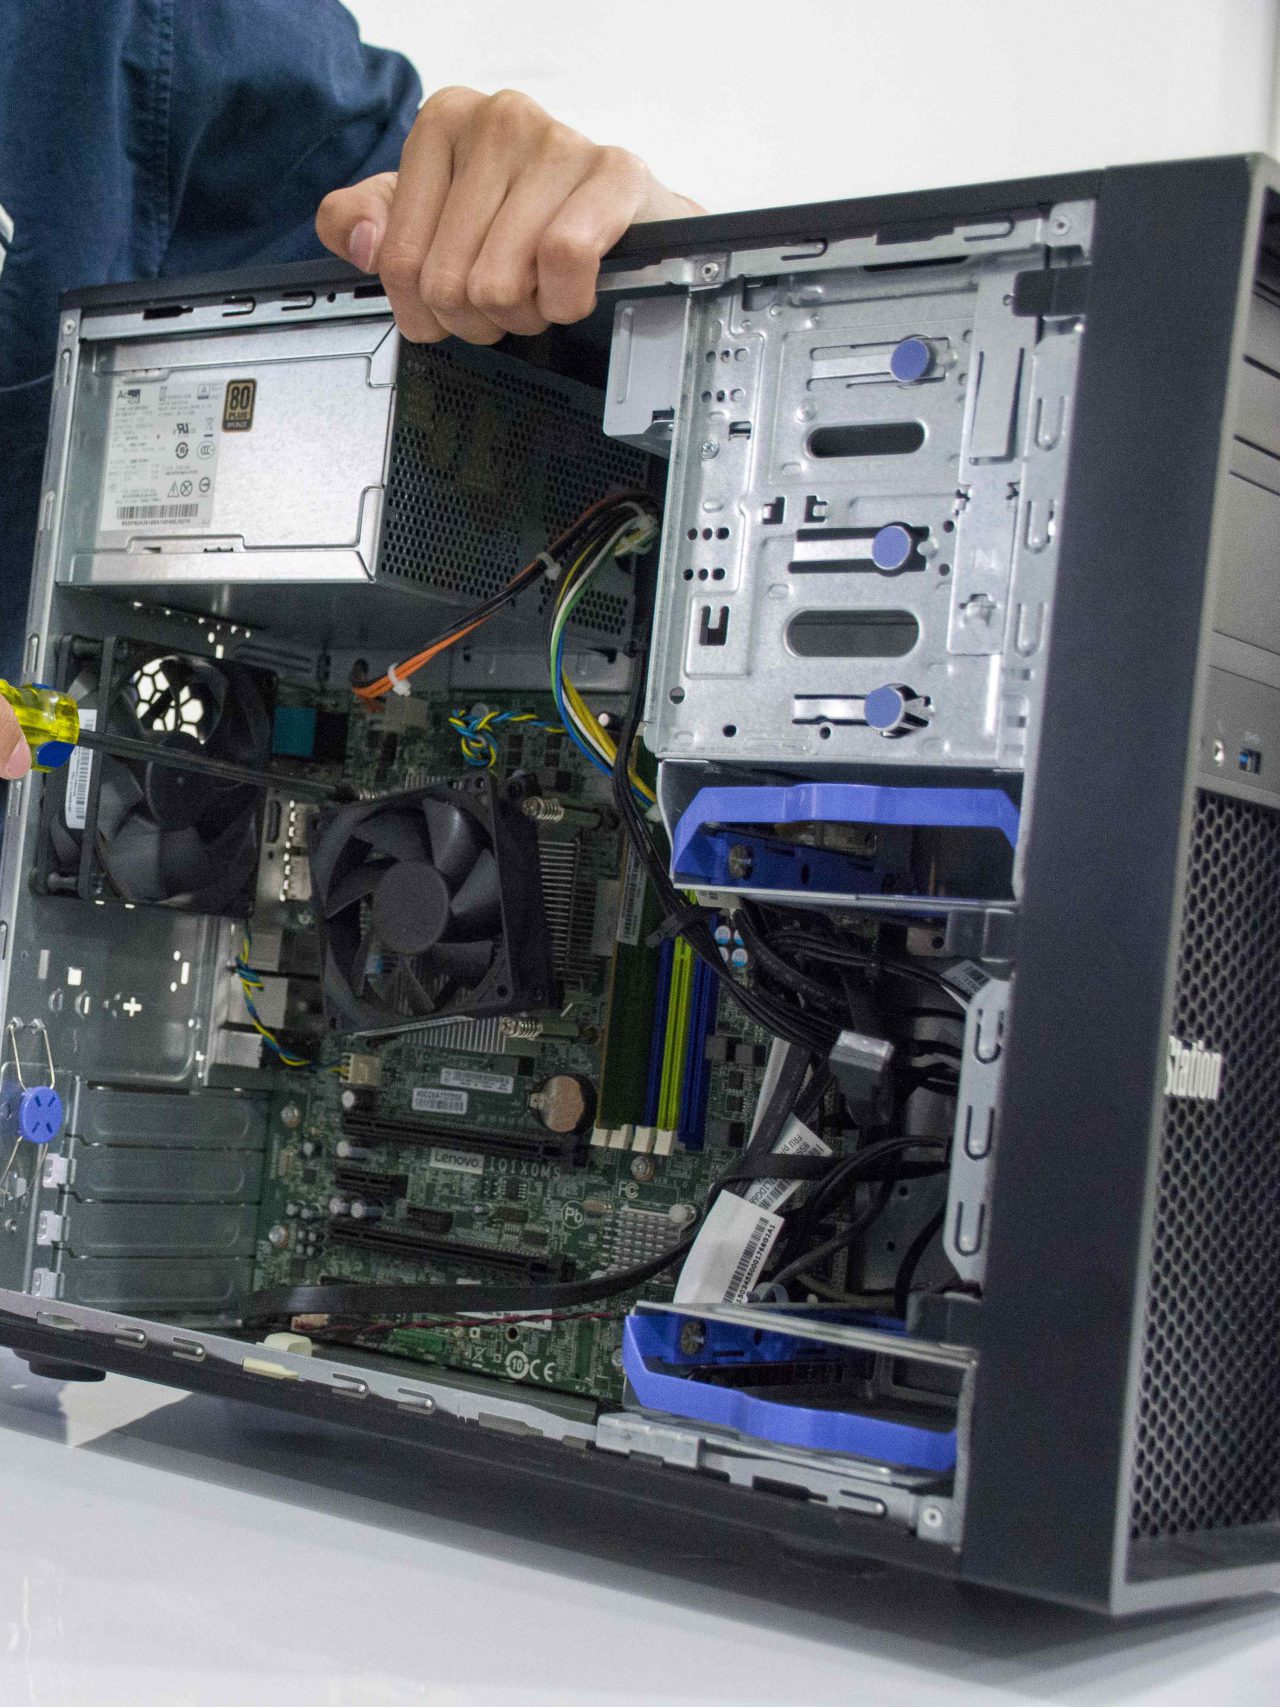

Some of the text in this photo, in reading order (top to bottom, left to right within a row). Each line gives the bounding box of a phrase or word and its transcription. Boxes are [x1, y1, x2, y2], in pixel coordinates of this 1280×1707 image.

[230, 385, 251, 411] 80
[228, 411, 249, 420] PLUS
[434, 1150, 479, 1169] Lenovo
[564, 1207, 584, 1224] Pb
[511, 1358, 524, 1371] 10
